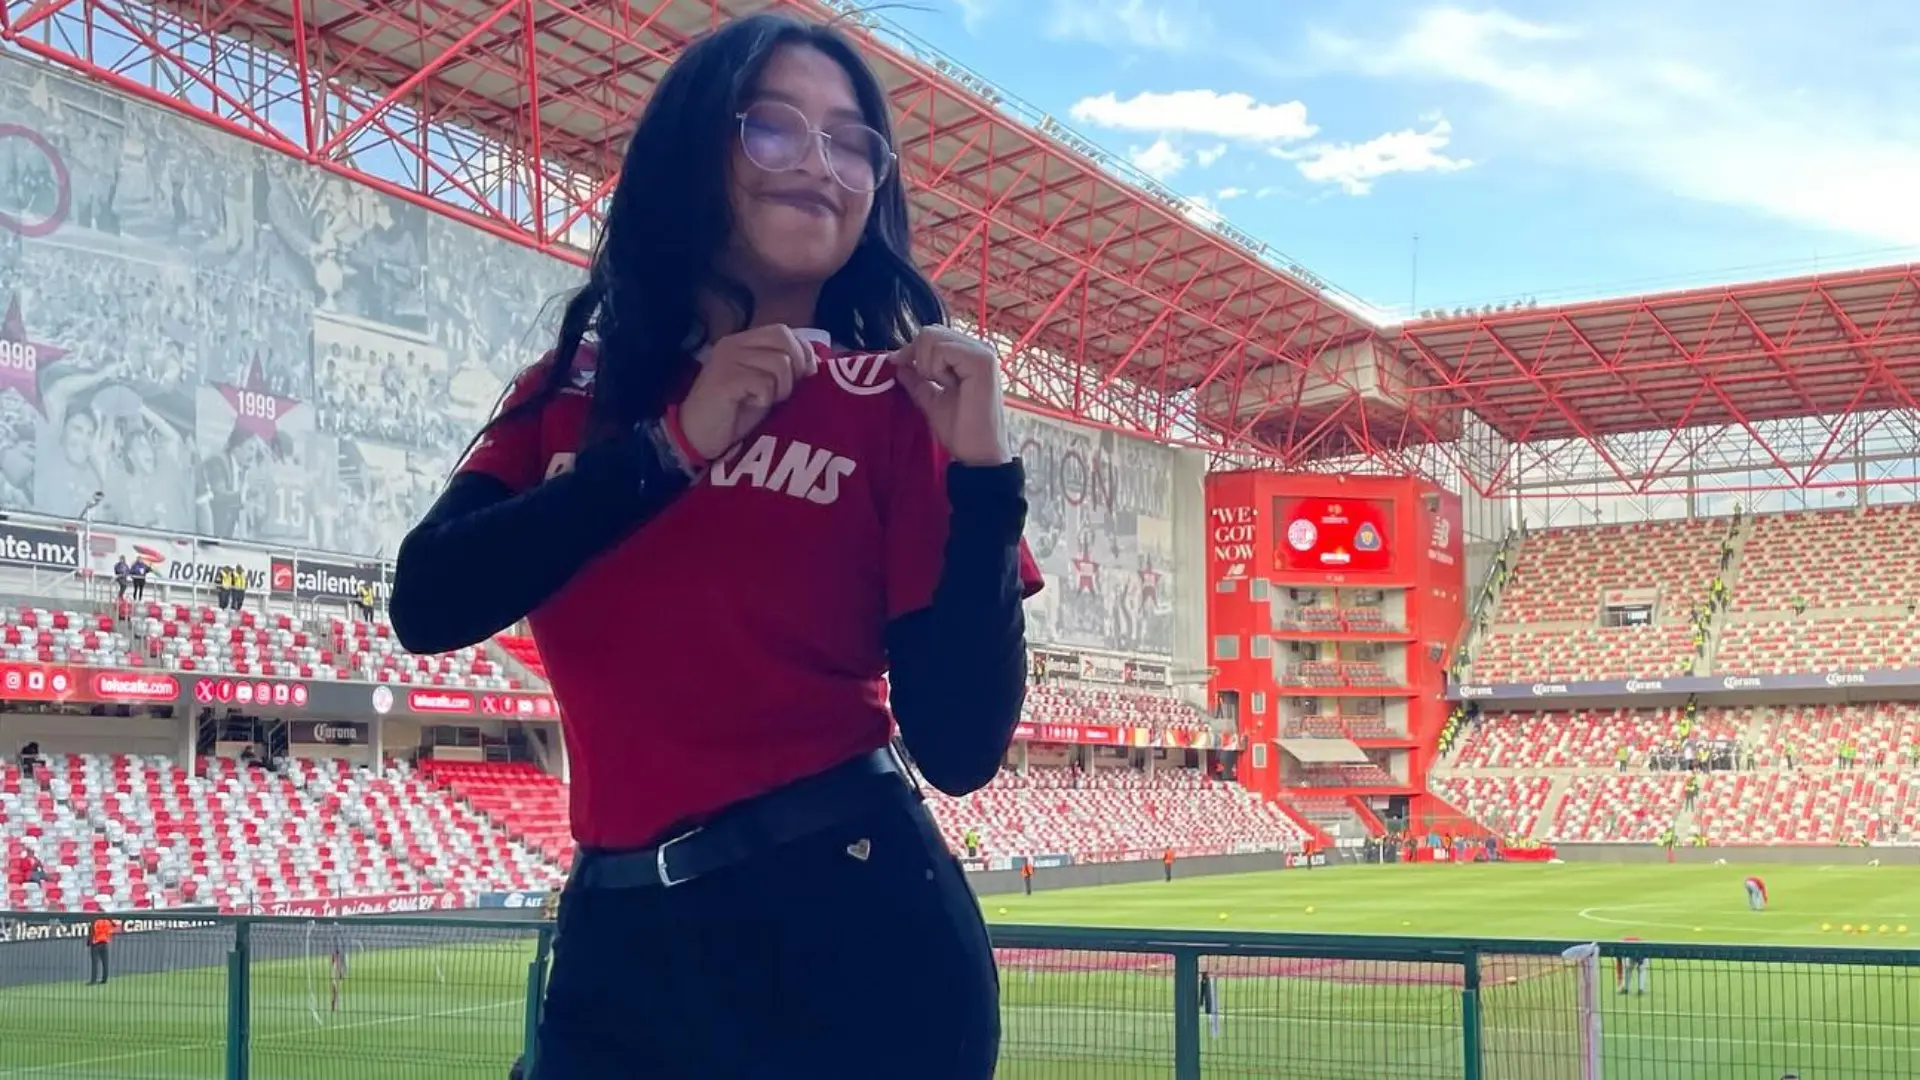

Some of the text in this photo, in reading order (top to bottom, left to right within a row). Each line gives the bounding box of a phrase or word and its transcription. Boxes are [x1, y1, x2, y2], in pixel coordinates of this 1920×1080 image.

[237, 391, 276, 421] 1999
[1217, 506, 1252, 524] WE
[1215, 524, 1256, 543] GOT
[1214, 543, 1256, 562] NOW
[1723, 676, 1761, 689] Corona
[1825, 672, 1864, 686] Corona
[313, 723, 357, 742] Corona
